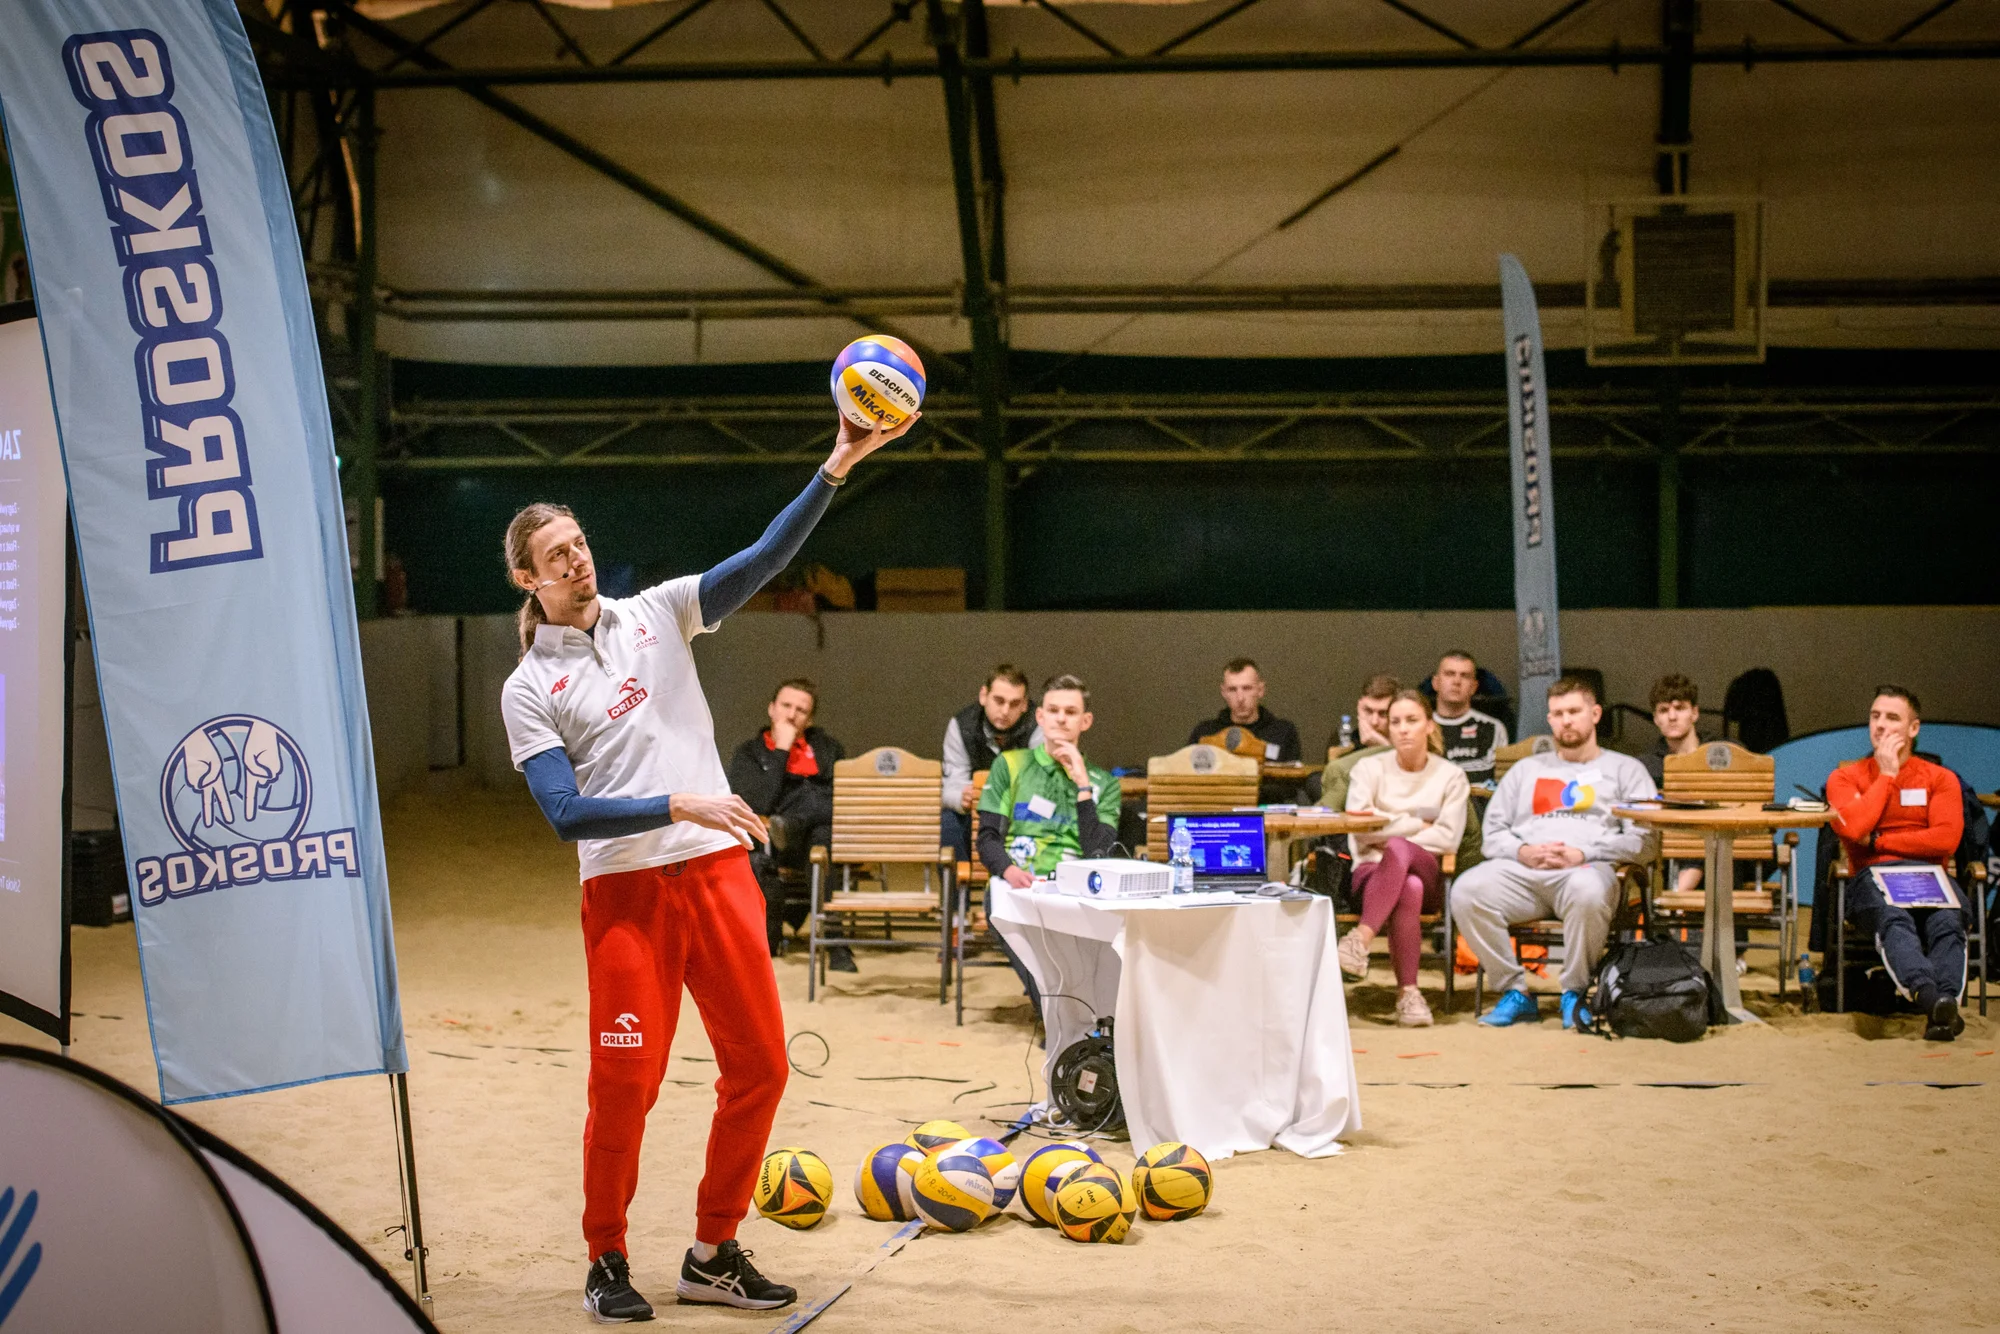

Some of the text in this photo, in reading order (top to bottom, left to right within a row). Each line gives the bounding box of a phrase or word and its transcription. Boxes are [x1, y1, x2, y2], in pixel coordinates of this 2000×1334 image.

[868, 369, 902, 395] BEACH
[901, 392, 917, 408] PRO
[551, 674, 569, 695] 4F
[610, 691, 646, 717] ORLEN
[602, 1034, 639, 1045] ORLEN
[761, 1159, 771, 1196] Wilson
